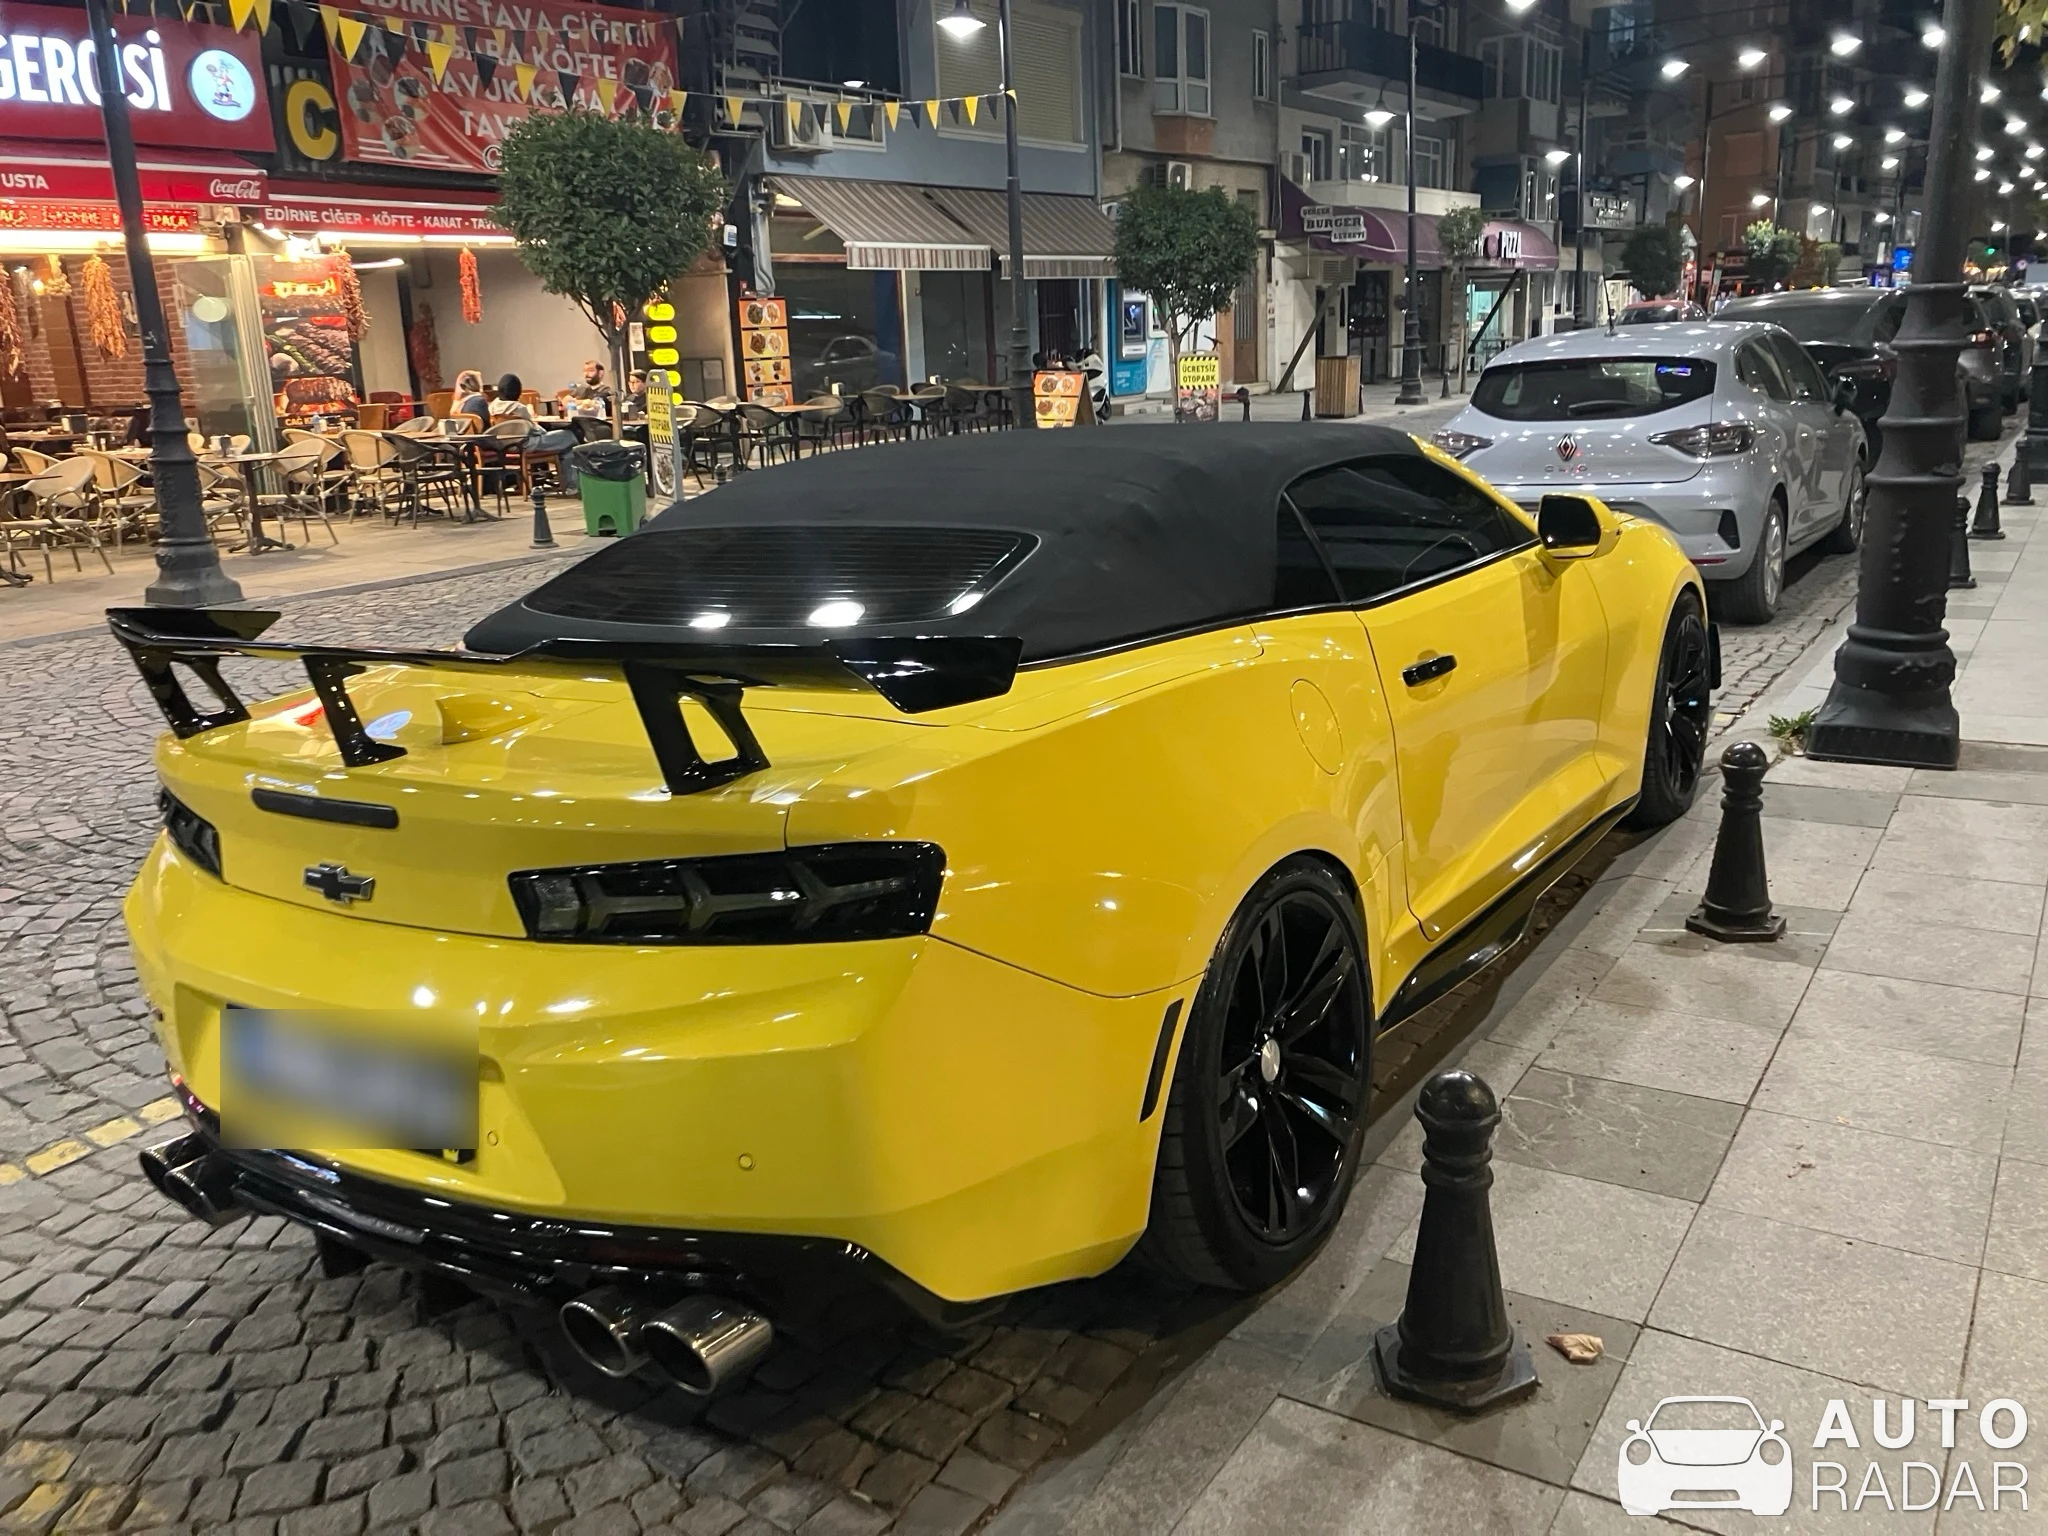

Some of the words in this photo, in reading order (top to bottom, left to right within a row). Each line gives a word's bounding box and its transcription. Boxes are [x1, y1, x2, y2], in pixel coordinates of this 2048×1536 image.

[360, 0, 470, 22] DRNE
[477, 0, 555, 36] TAVA
[531, 43, 618, 80] KÖFTE
[530, 83, 610, 116] KANA
[1, 173, 49, 190] USTA
[264, 206, 320, 223] EDİRNE
[321, 207, 363, 225] CİĞER
[372, 210, 414, 228] KÖFTE
[423, 215, 463, 229] KANAT
[1306, 216, 1362, 229] BURGER
[1182, 362, 1216, 373] ÜCRETSİZ
[1182, 374, 1216, 383] OTOPARK
